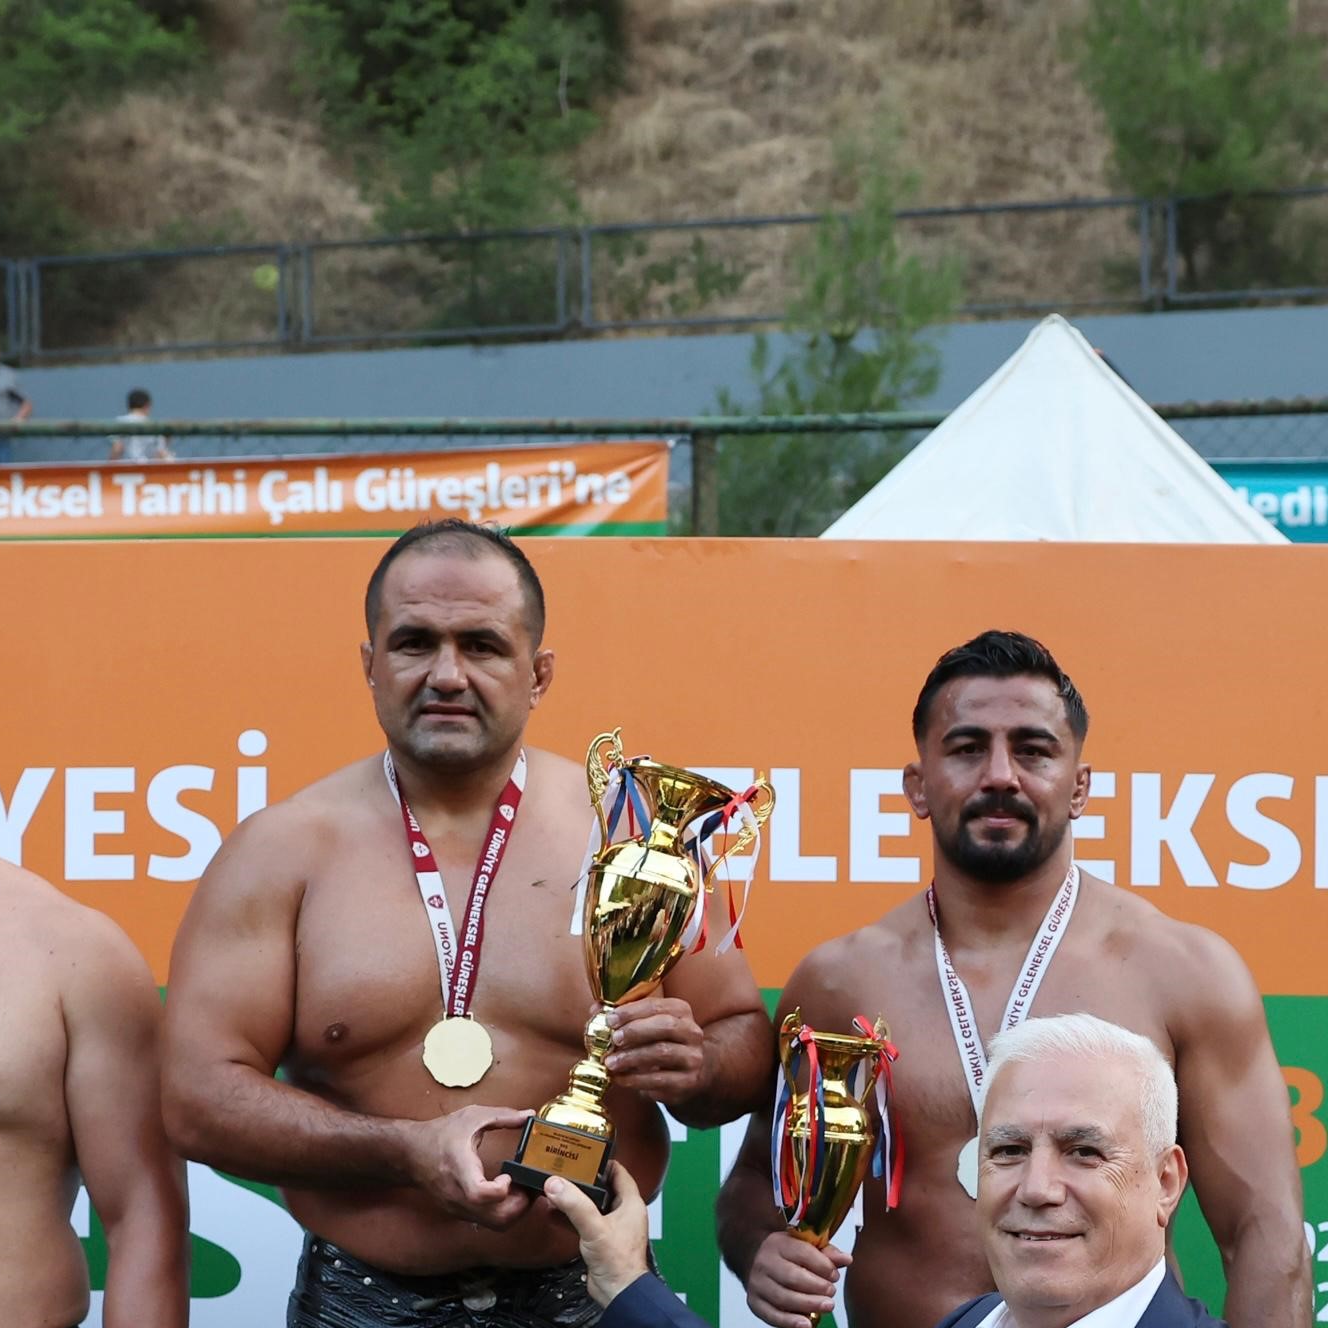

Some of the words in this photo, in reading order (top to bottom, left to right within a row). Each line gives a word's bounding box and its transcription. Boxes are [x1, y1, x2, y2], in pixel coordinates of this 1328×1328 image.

[113, 467, 247, 517] Tarihi
[258, 466, 343, 525] Çalı
[354, 459, 632, 519] Güreşleri'ne
[482, 828, 506, 874] TÜRKİYE
[463, 874, 489, 947] GELENEKSEL
[453, 949, 476, 1017] GÜREŞLER
[1018, 935, 1054, 999] GELENEKSEL
